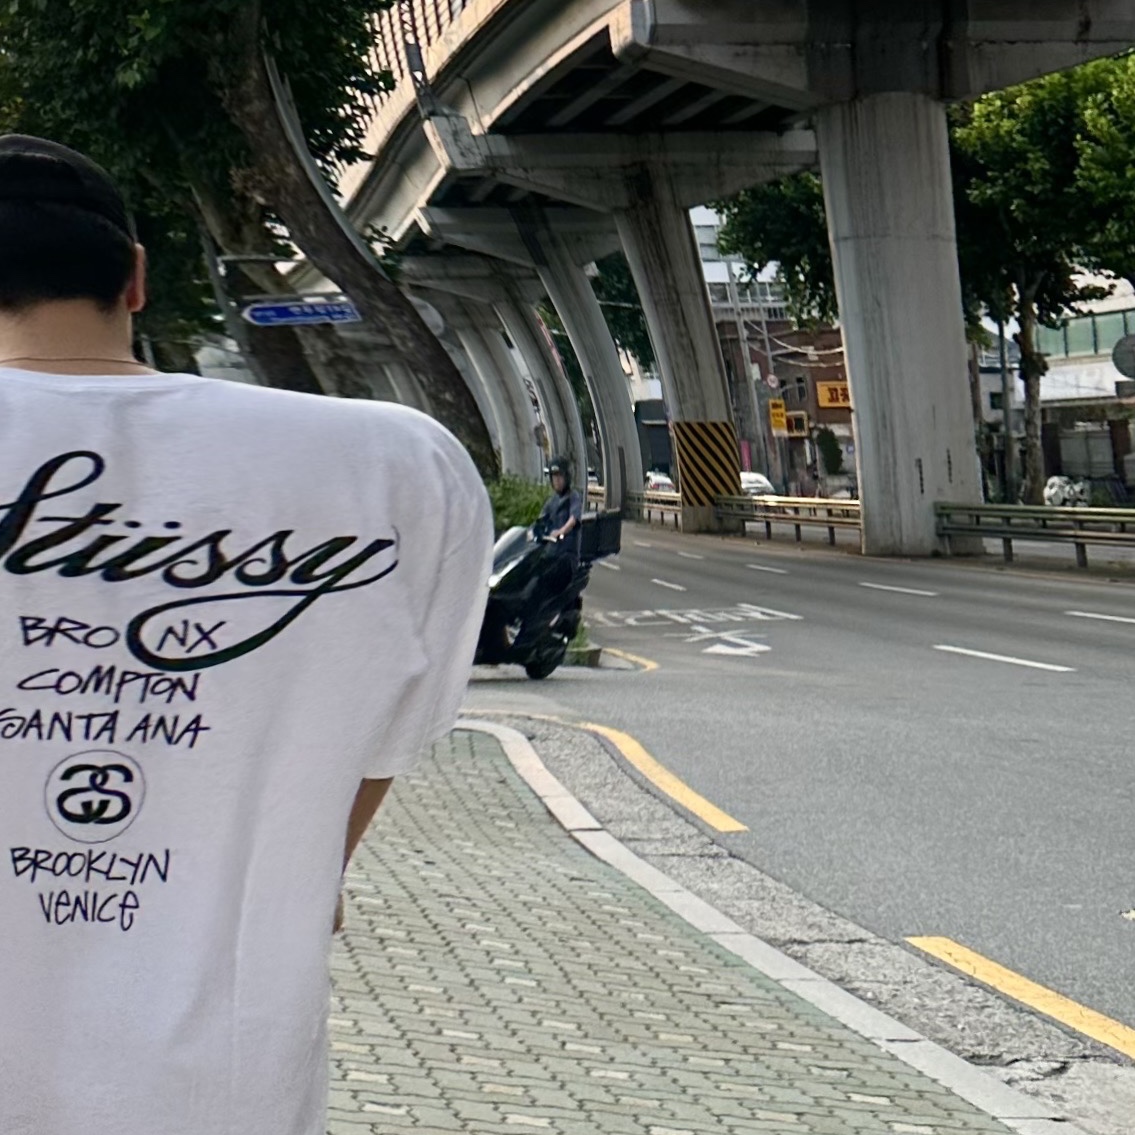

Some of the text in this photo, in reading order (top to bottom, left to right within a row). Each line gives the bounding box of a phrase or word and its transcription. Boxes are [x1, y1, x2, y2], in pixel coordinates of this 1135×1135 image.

[17, 665, 200, 704] COMPTON
[126, 713, 211, 748] ANA
[10, 846, 170, 885] BROOKLYN
